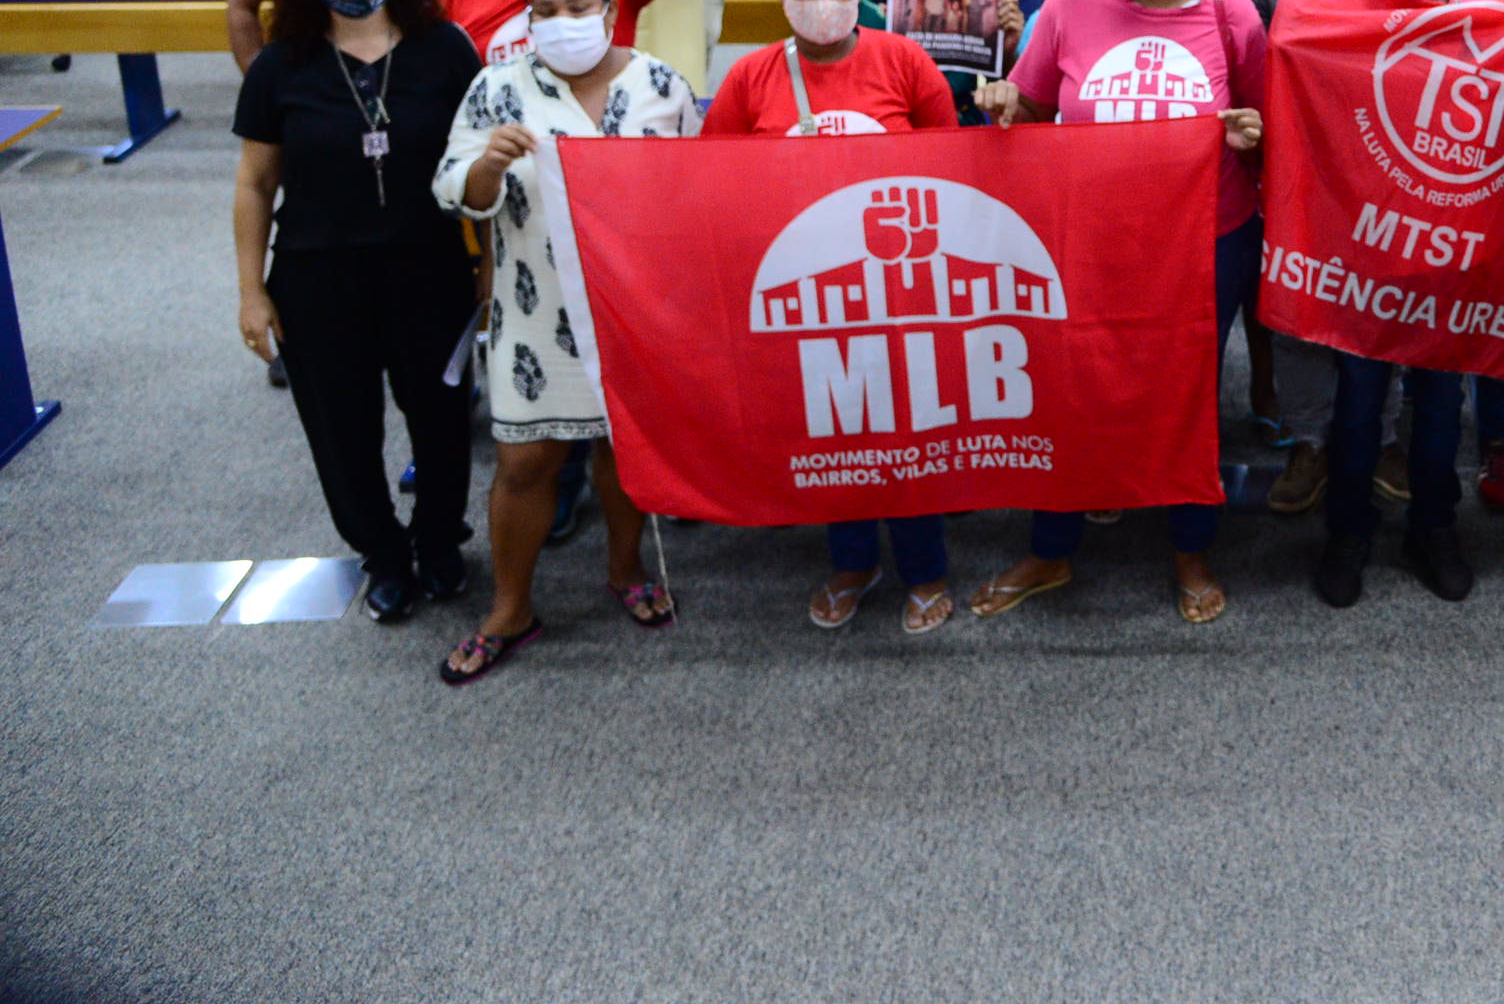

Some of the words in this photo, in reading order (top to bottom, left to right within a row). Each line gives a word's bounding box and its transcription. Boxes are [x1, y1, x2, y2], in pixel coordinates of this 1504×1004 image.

[1354, 107, 1371, 133] NA
[1362, 131, 1392, 173] LUTA
[1412, 130, 1488, 170] BRASIL
[1387, 166, 1424, 200] PELA
[1426, 186, 1491, 208] REFORMA
[1351, 202, 1485, 272] MTST
[798, 324, 1034, 438] MLB
[790, 447, 920, 471] MOVIMENTO
[926, 439, 950, 458] DE
[956, 434, 1007, 453] LUTA
[1012, 435, 1054, 453] NOS
[793, 469, 887, 488] BAIRROS,
[892, 458, 949, 481] VILAS
[954, 456, 964, 471] E
[969, 453, 1053, 471] FAVELAS
